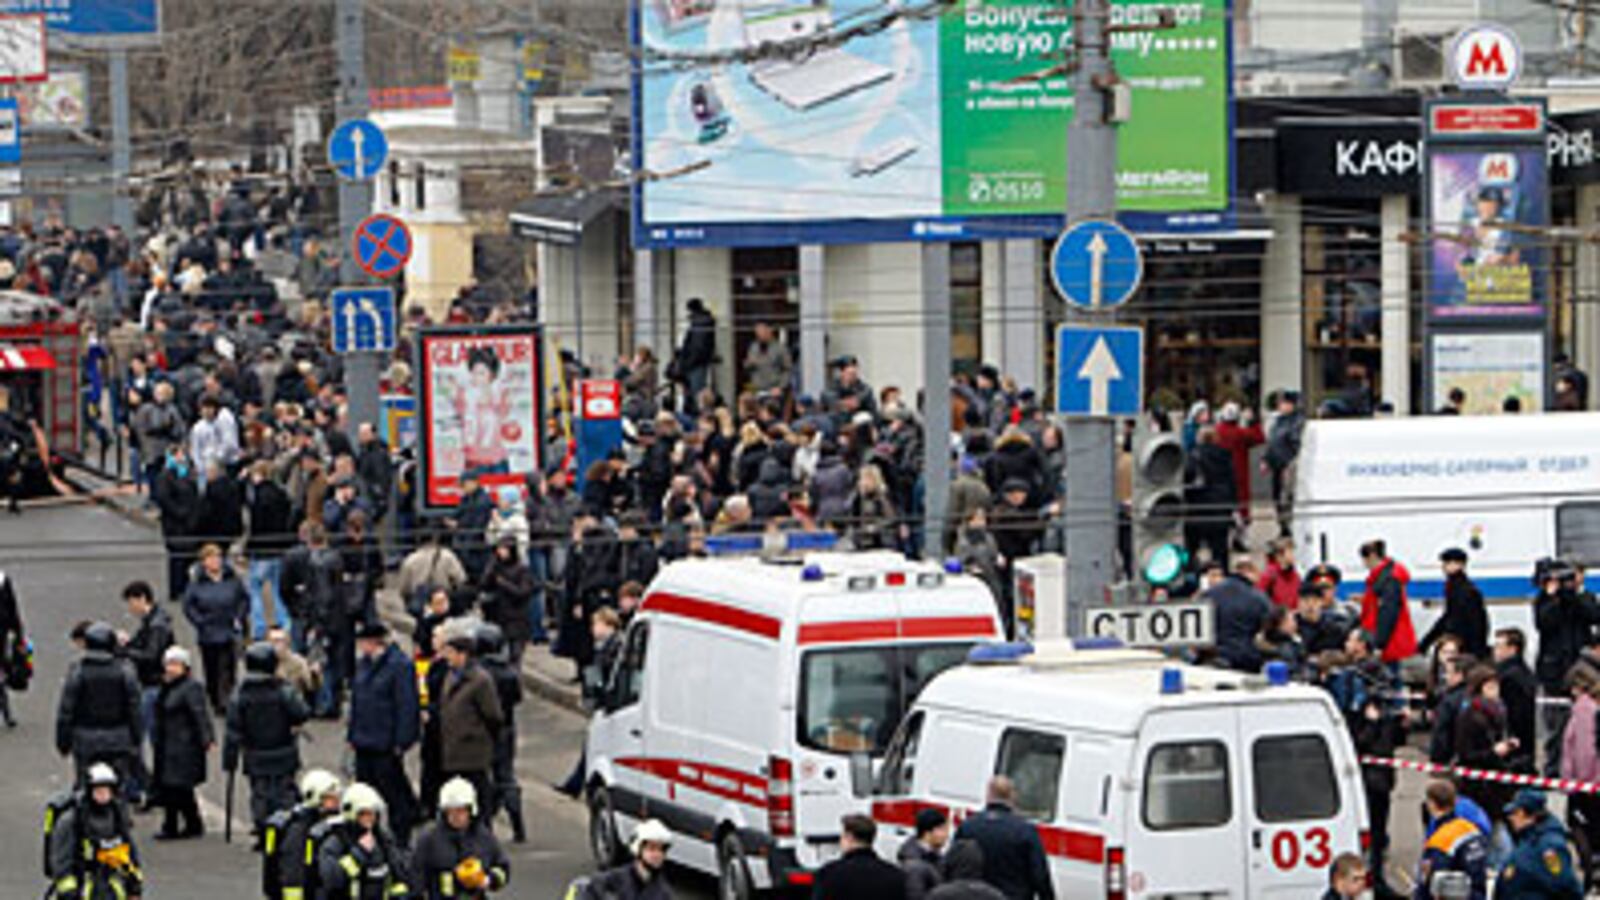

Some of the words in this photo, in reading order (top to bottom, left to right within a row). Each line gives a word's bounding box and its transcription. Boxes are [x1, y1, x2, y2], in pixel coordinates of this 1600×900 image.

[965, 32, 1053, 60] новую
[1467, 41, 1507, 75] М
[1336, 140, 1424, 176] КАФ
[1093, 608, 1202, 641] СТОП
[1271, 827, 1332, 870] 03
